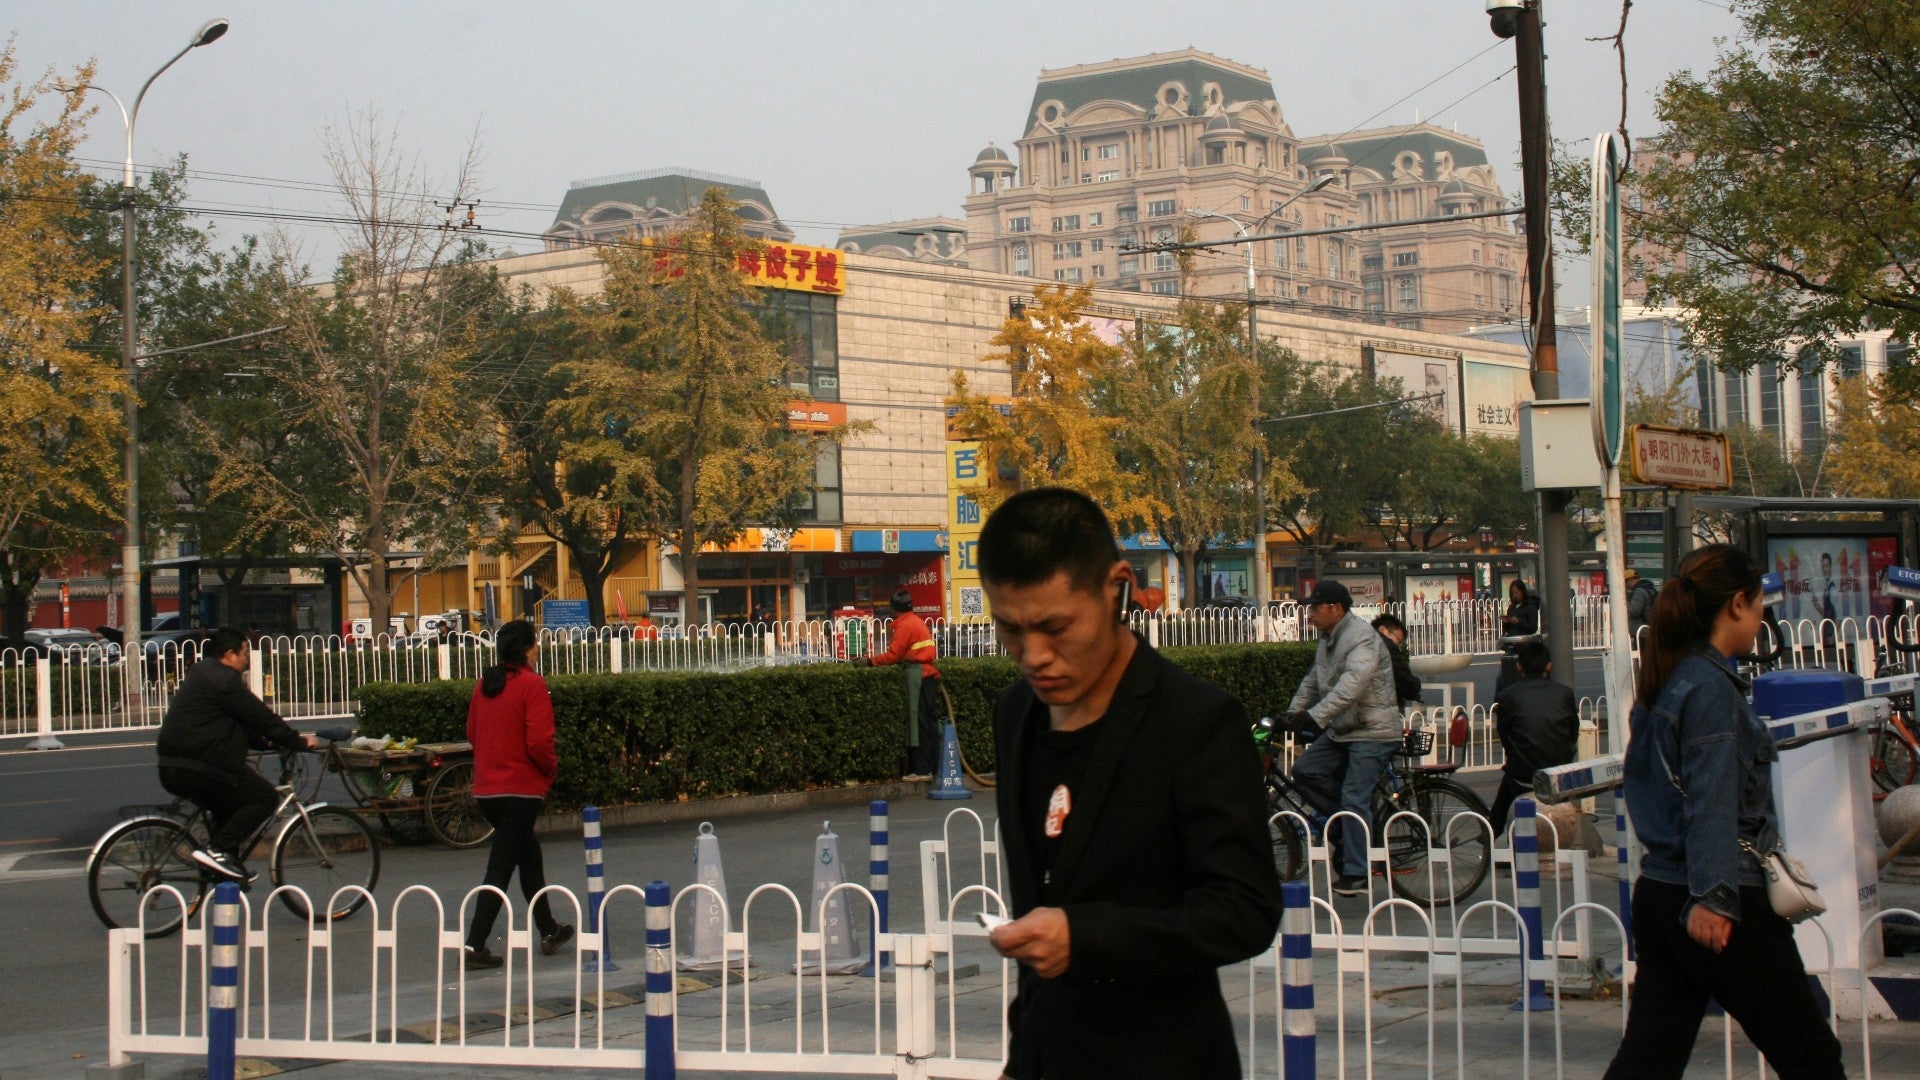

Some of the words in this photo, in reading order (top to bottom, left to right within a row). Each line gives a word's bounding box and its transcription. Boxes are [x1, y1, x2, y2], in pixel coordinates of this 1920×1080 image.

[1478, 404, 1512, 425] 社会主义
[1648, 438, 1711, 466] 朝阳门外大街
[954, 448, 981, 570] 百脑汇
[948, 741, 957, 777] ETCP
